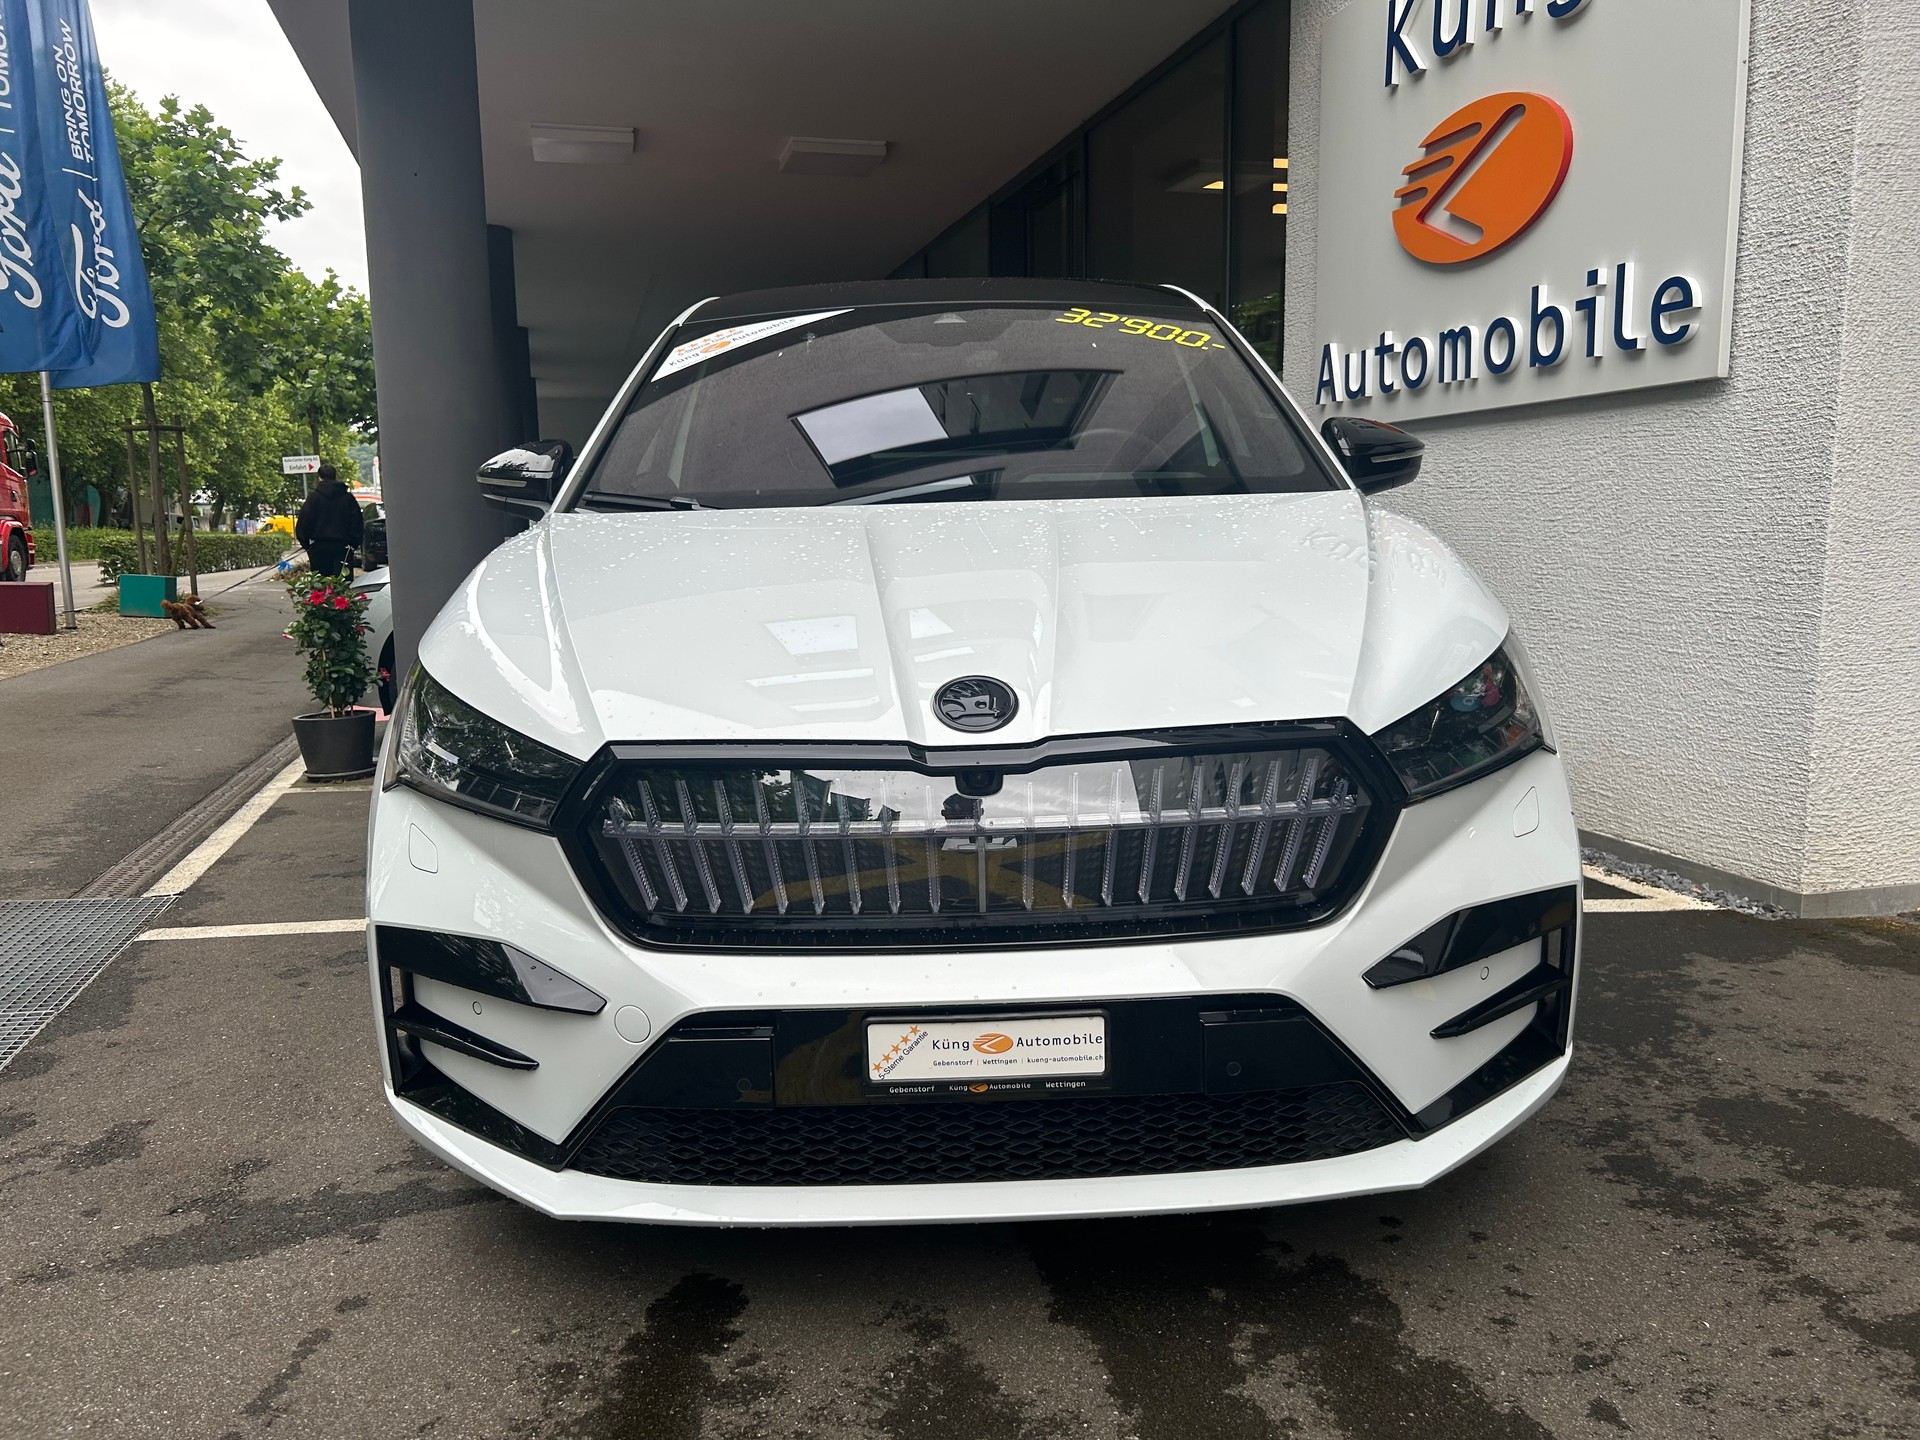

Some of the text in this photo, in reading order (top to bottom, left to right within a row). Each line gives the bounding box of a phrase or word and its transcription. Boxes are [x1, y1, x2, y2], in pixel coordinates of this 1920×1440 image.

[53, 44, 85, 161] BRING ON
[60, 18, 94, 164] TOMORROW
[71, 188, 130, 328] Ford
[732, 319, 796, 342] Automobile
[1315, 262, 1702, 405] Automobile
[878, 1031, 929, 1080] 5-Sterne Garantie
[932, 1033, 1104, 1052] Küng Automobile
[933, 1053, 1104, 1067] Gebenstorf Wettingen kueng-automobile.ch
[889, 1080, 1087, 1094] Gebenstorf Küng Automobile Wettingen
